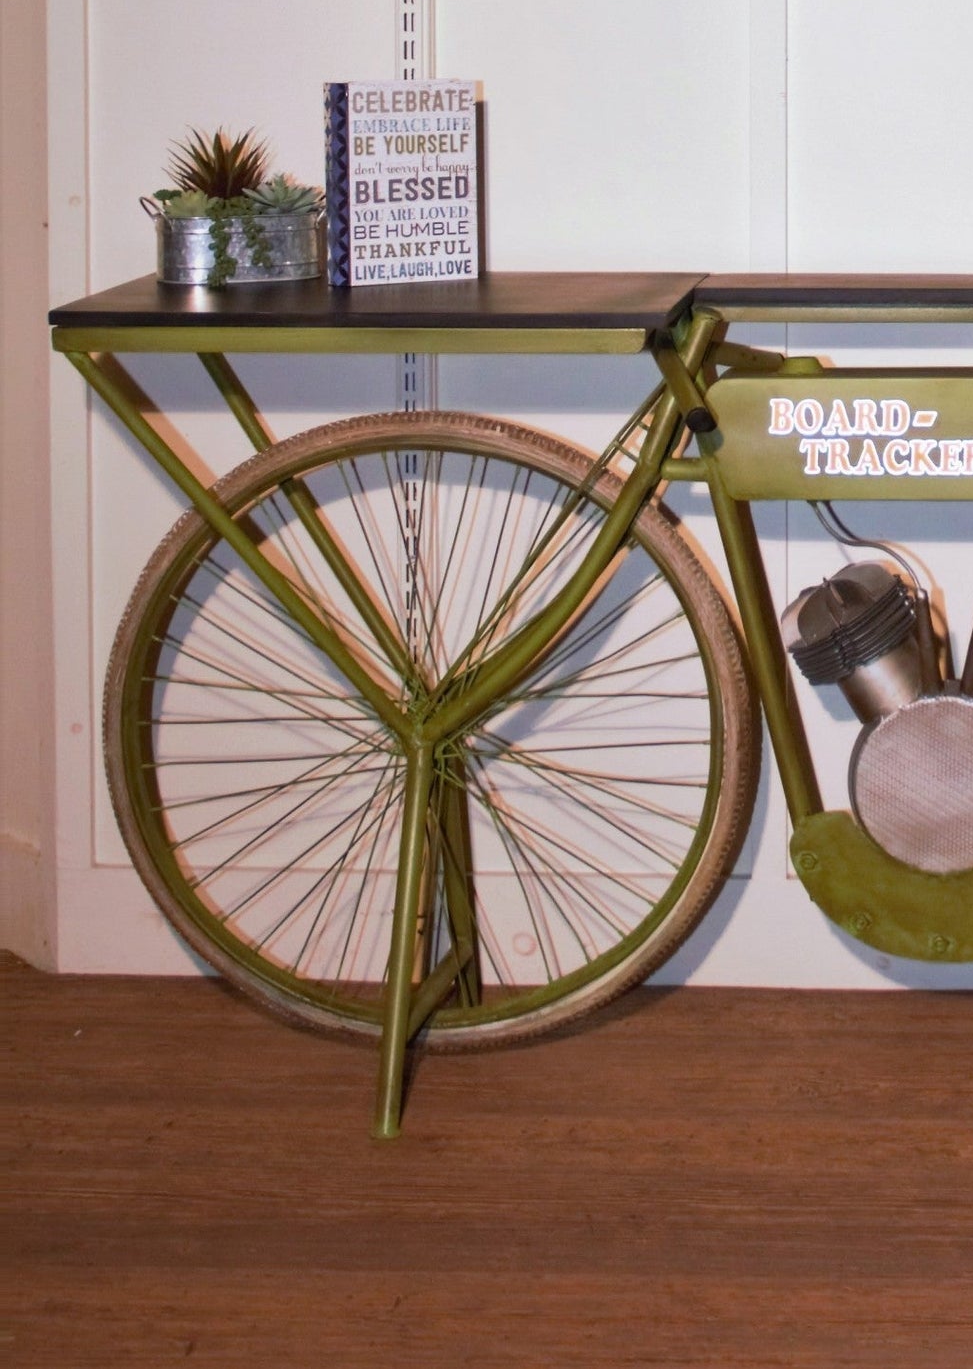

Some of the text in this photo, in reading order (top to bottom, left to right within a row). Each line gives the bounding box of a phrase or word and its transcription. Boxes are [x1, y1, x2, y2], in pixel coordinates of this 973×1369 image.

[352, 89, 470, 114] CELEBRATE
[353, 117, 471, 133] EMBRACE LIFE
[354, 133, 469, 156] BE YOURSELF
[354, 161, 382, 176] don't
[386, 164, 419, 183] worry
[421, 155, 433, 173] be
[355, 176, 469, 204] BLESSED
[354, 205, 469, 223] YOU ARE LOVED
[353, 221, 469, 240] BE HUMBLE
[354, 240, 471, 260] THANKFUL
[768, 398, 938, 436] BOARD-
